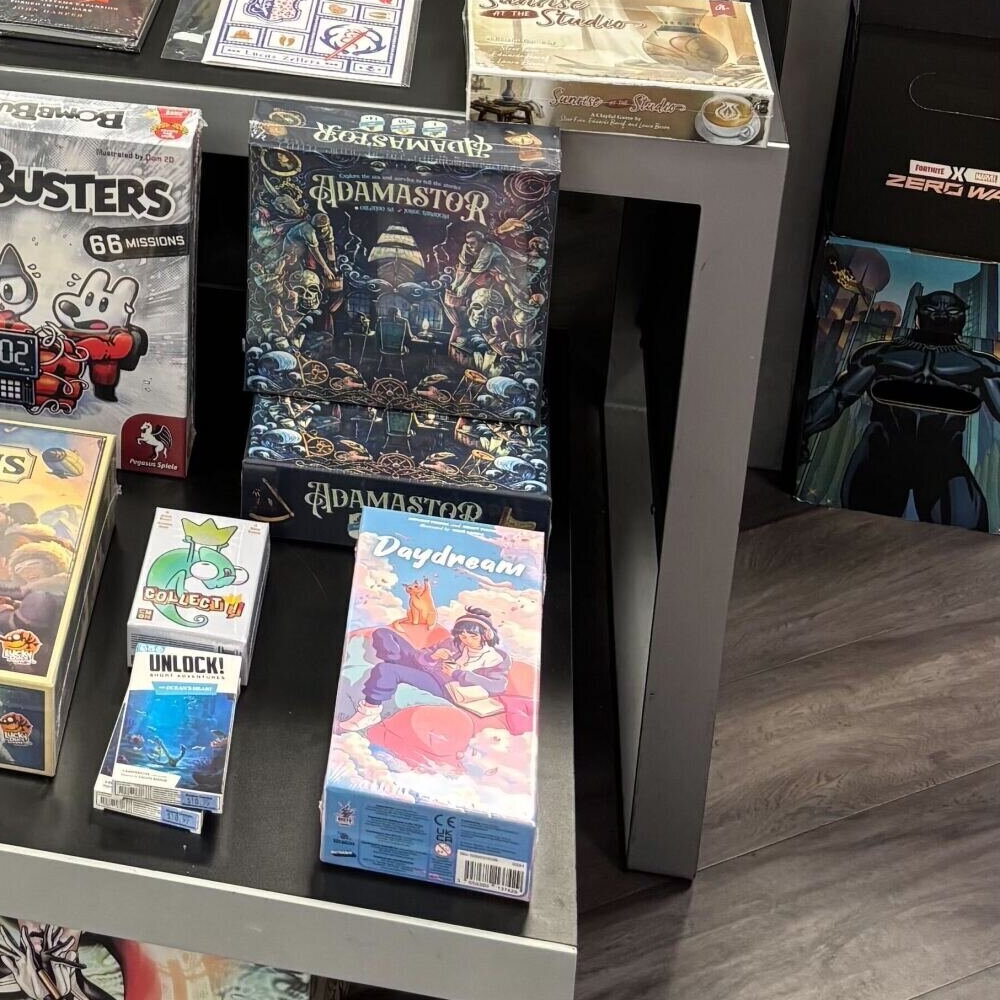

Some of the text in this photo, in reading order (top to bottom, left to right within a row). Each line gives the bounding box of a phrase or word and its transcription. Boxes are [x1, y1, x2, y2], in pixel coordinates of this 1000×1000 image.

[511, 9, 531, 18] THE
[535, 9, 638, 30] Studio
[550, 87, 687, 114] Sunrise Studio
[134, 152, 144, 161] by
[914, 163, 966, 182] FORTNITE X
[885, 173, 964, 197] ZERO
[308, 174, 490, 226] ADAMASTOR
[88, 234, 185, 255] 66 MISSIONS
[128, 457, 179, 471] Pegasus Spiele
[303, 481, 483, 522] ADAMASTOR
[375, 535, 527, 579] Daydream
[149, 653, 225, 675] UNLOCK!
